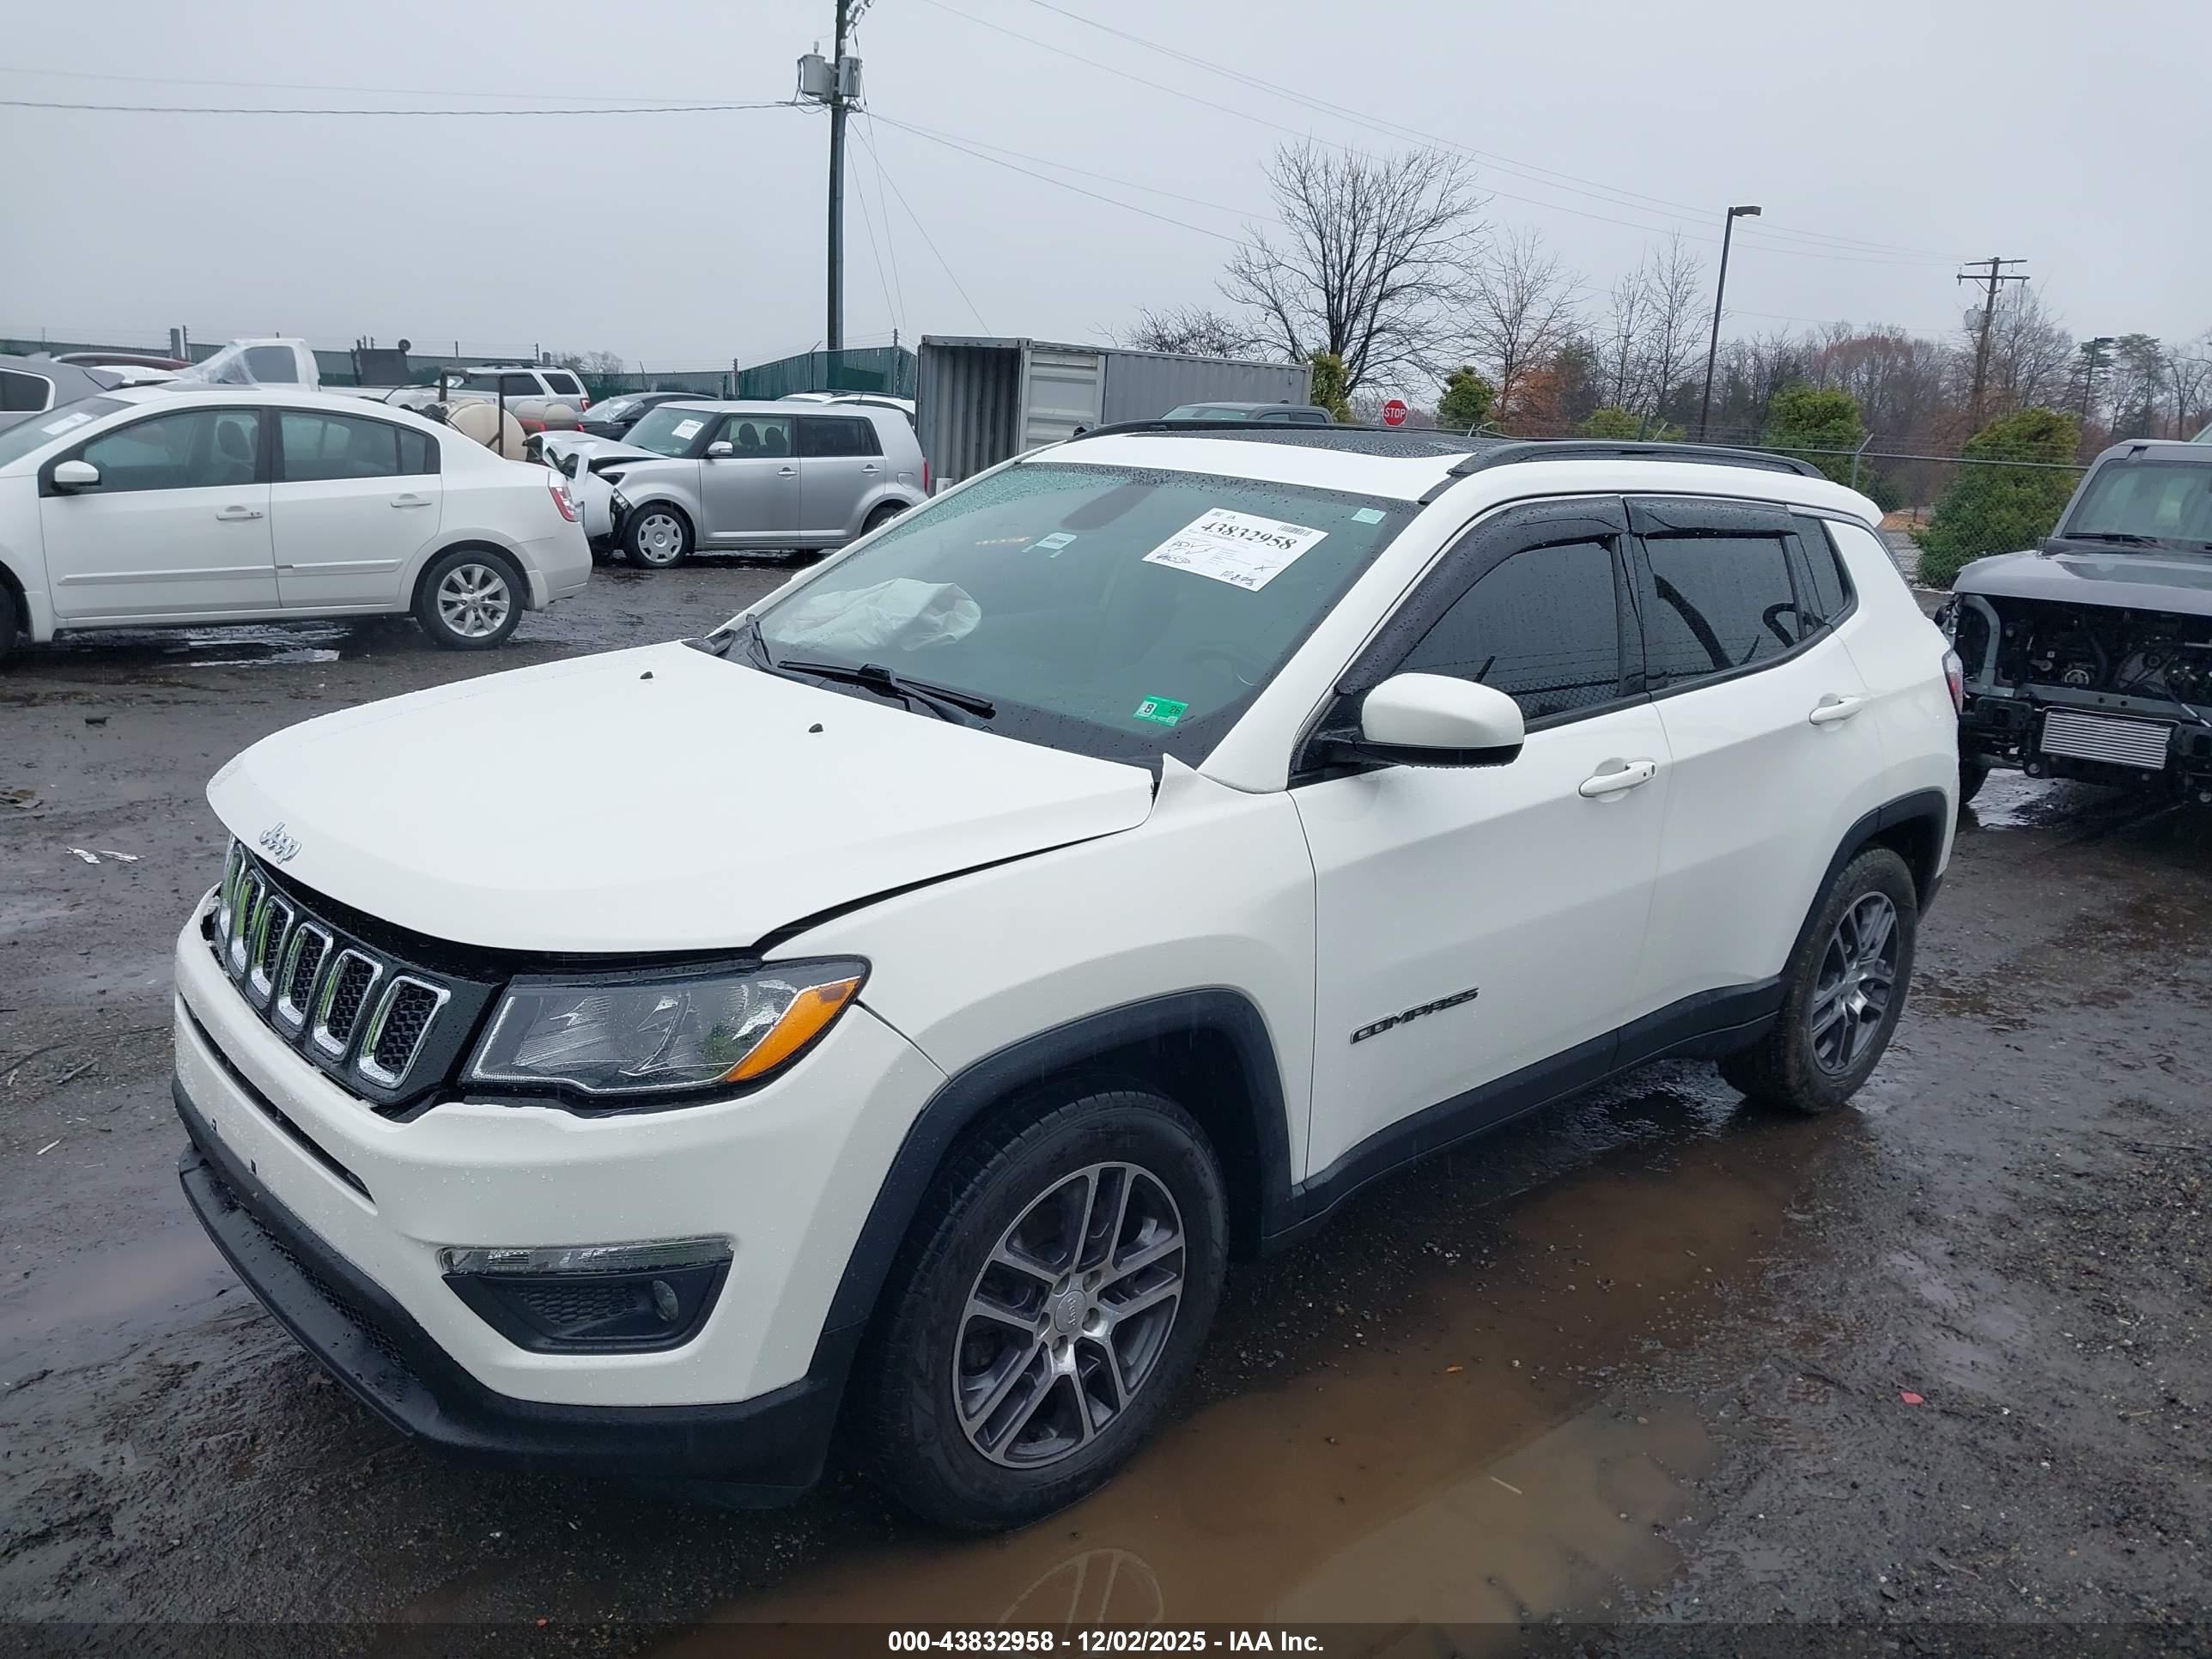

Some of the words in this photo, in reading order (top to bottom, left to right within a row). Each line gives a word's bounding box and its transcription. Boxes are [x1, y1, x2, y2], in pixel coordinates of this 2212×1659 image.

[1384, 407, 1406, 419] STOP
[1201, 522, 1297, 550] 43832958
[1145, 704, 1154, 714] 8
[259, 822, 302, 865] Jeep
[1350, 986, 1480, 1044] COMPASS
